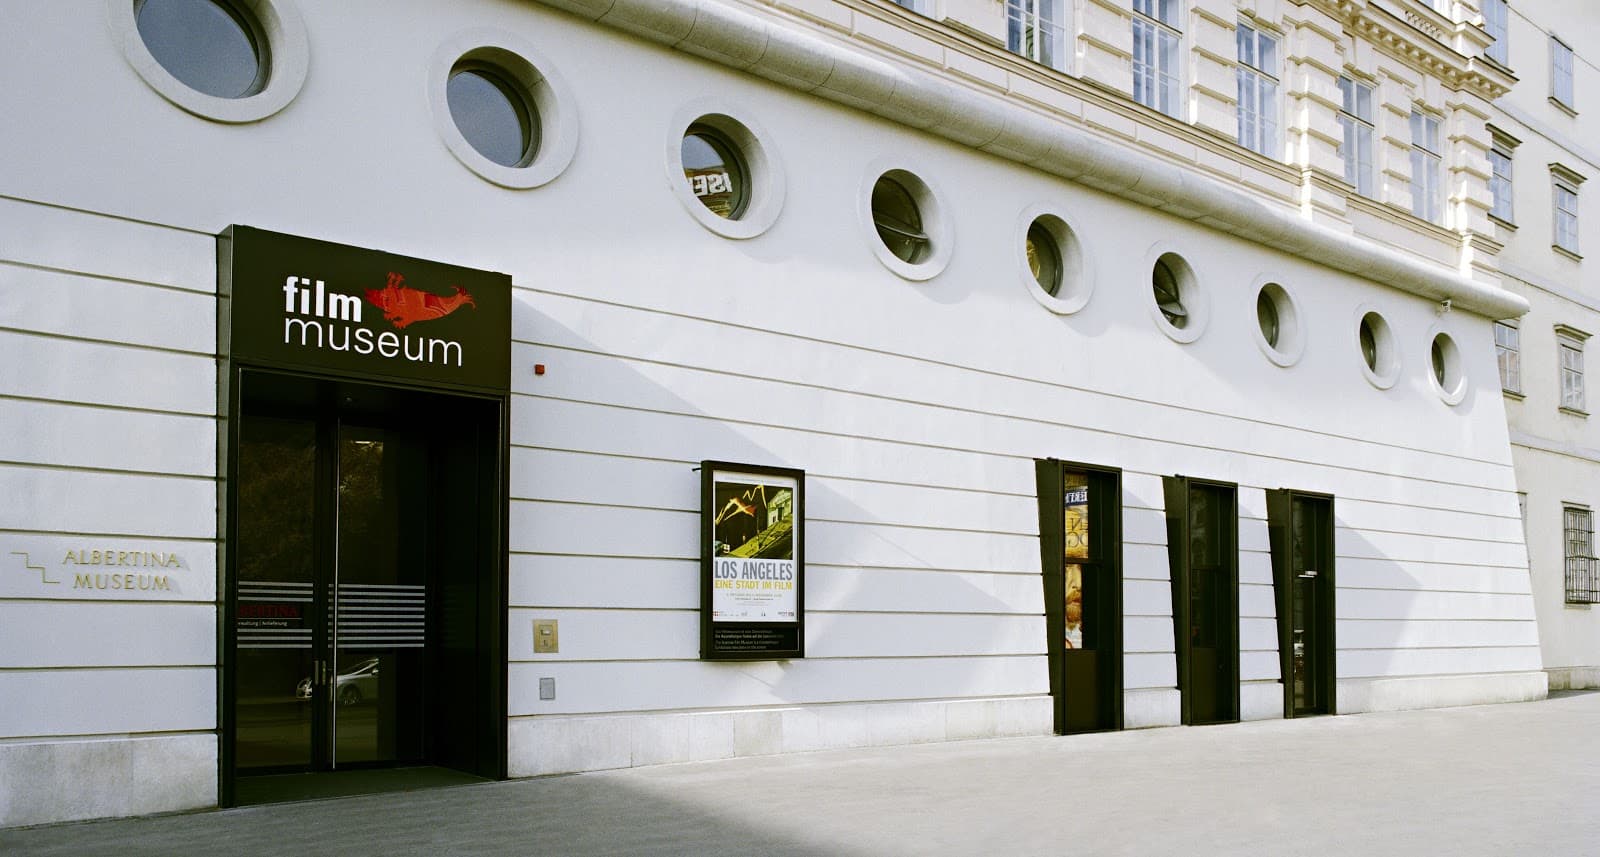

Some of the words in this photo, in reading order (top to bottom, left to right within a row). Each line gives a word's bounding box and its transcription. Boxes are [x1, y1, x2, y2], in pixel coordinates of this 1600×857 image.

[283, 276, 362, 323] film
[284, 317, 463, 368] museum
[62, 549, 182, 568] ALBERTINA
[714, 560, 738, 579] LOS
[742, 561, 793, 581] ANGELES
[73, 573, 172, 591] MUSEUM
[715, 579, 733, 589] EINE
[736, 580, 760, 590] STADT
[762, 581, 772, 590] IM
[774, 581, 793, 591] FILM
